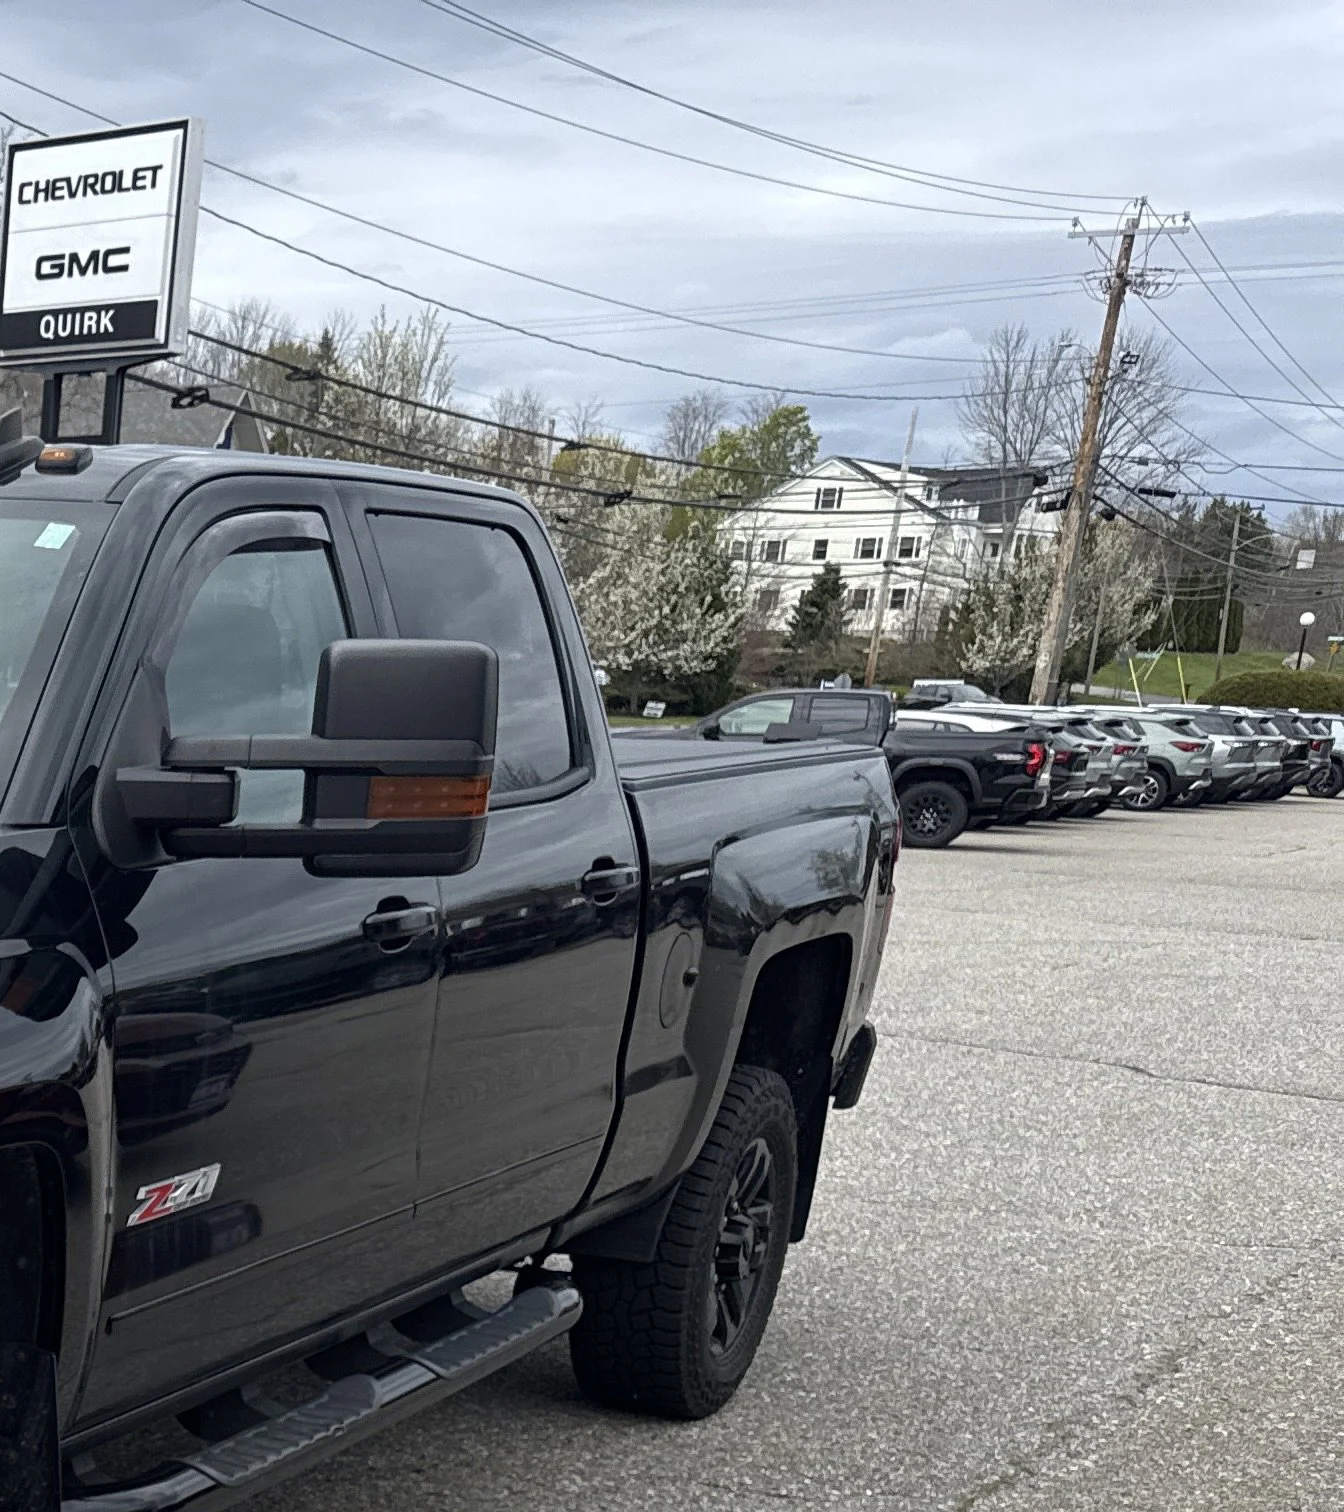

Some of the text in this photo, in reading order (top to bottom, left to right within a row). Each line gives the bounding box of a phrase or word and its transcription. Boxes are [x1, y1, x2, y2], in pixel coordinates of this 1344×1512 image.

[17, 164, 164, 206] CHEVROLET
[34, 245, 132, 281] GMC
[39, 308, 116, 339] QUIRK
[126, 1161, 222, 1228] Z71
